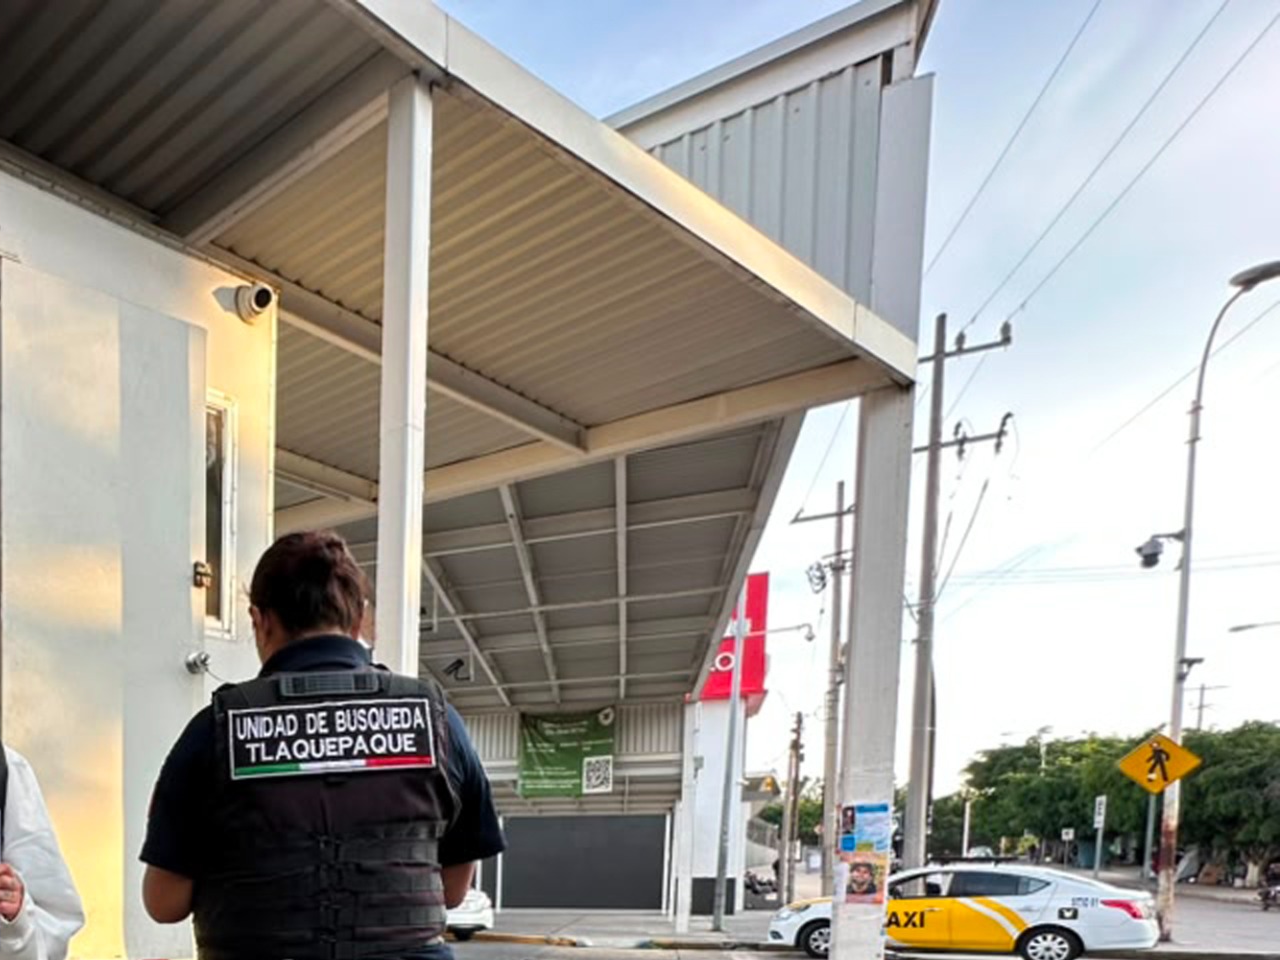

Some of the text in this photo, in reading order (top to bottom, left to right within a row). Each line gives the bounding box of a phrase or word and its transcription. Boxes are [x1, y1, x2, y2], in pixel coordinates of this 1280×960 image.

[236, 706, 425, 740] UNIDAD DE BUSQUEDA
[245, 732, 417, 763] TLAQUEPAQUE
[884, 911, 925, 928] AXI
